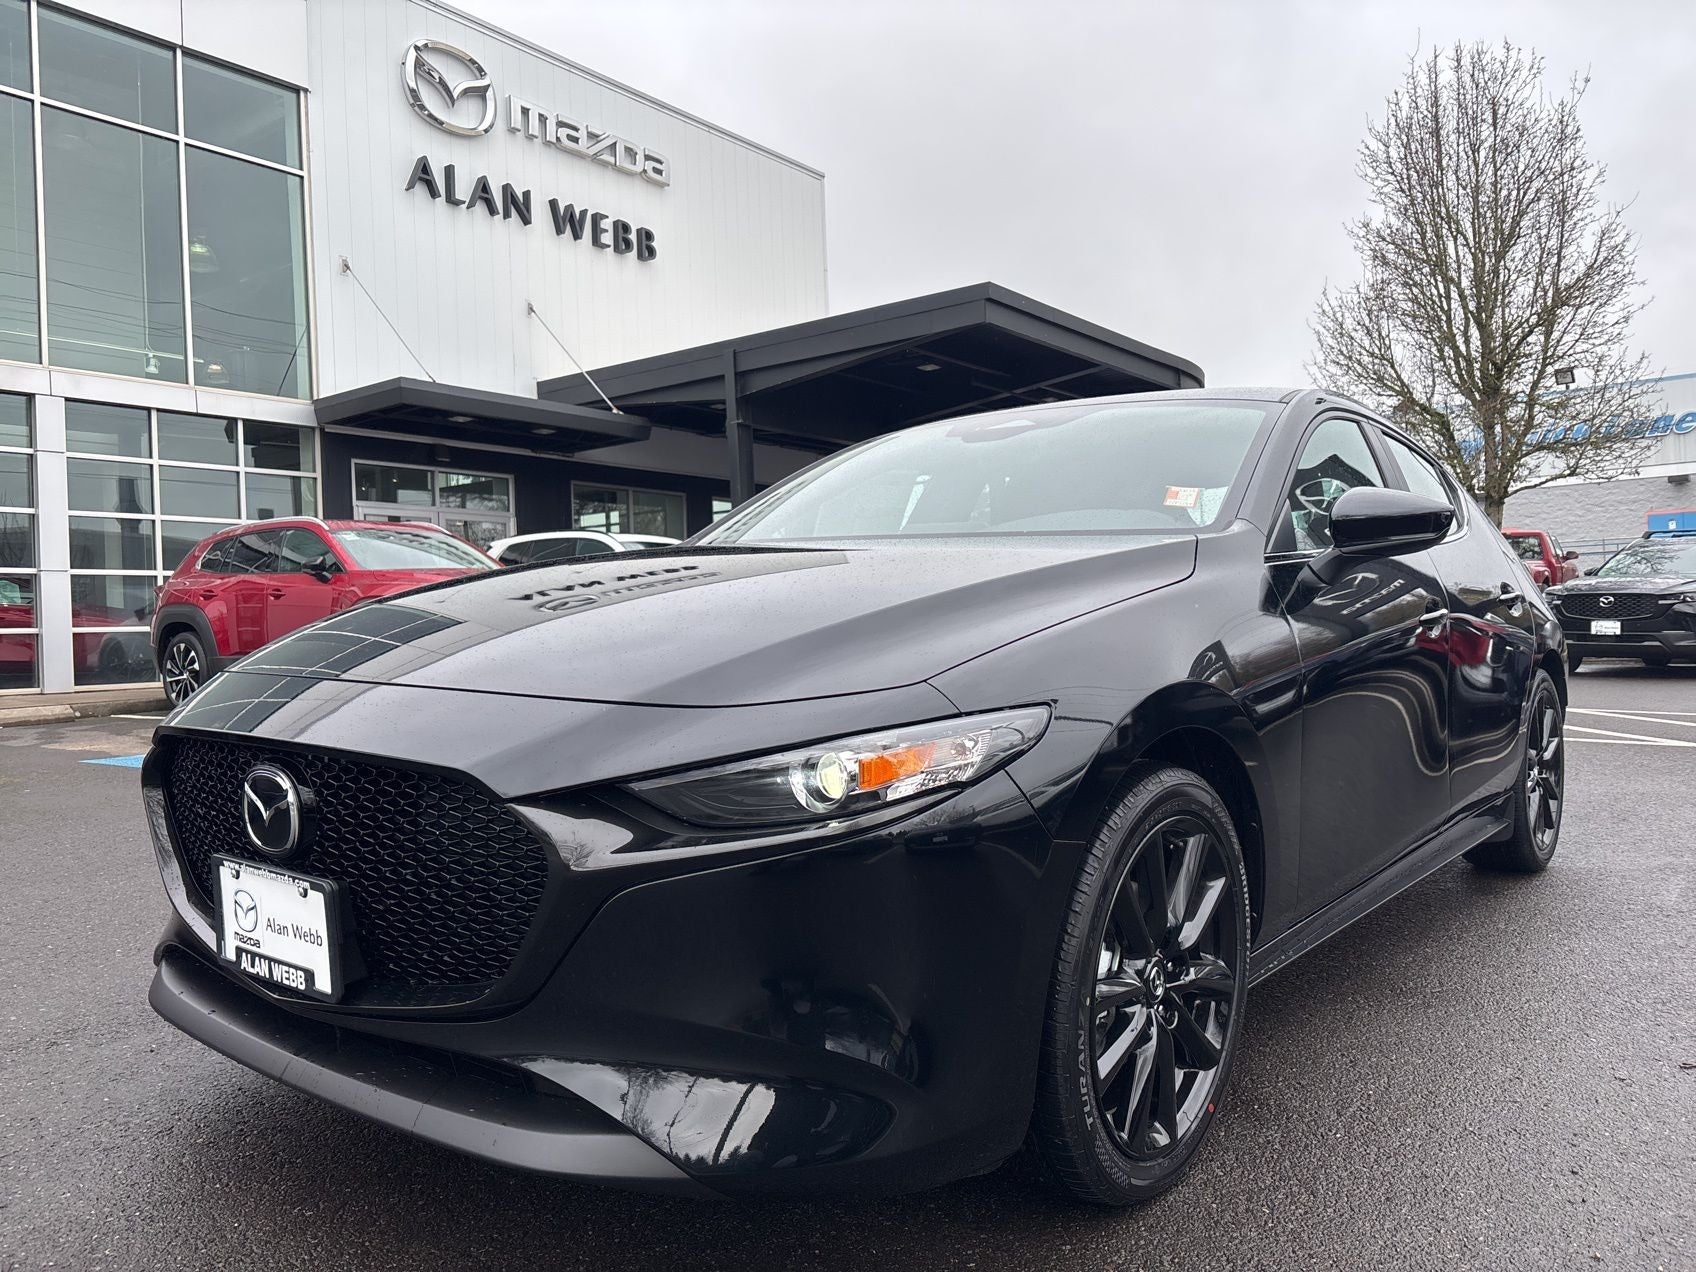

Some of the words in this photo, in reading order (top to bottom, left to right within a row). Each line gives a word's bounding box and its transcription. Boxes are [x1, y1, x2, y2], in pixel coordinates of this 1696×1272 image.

[505, 94, 670, 188] mazda
[405, 155, 532, 226] ALAN
[548, 198, 657, 262] WEBB
[233, 931, 261, 949] mazda
[265, 917, 289, 938] Alan
[291, 923, 323, 947] Webb
[240, 952, 270, 979] ALAN
[271, 961, 306, 991] WEBB
